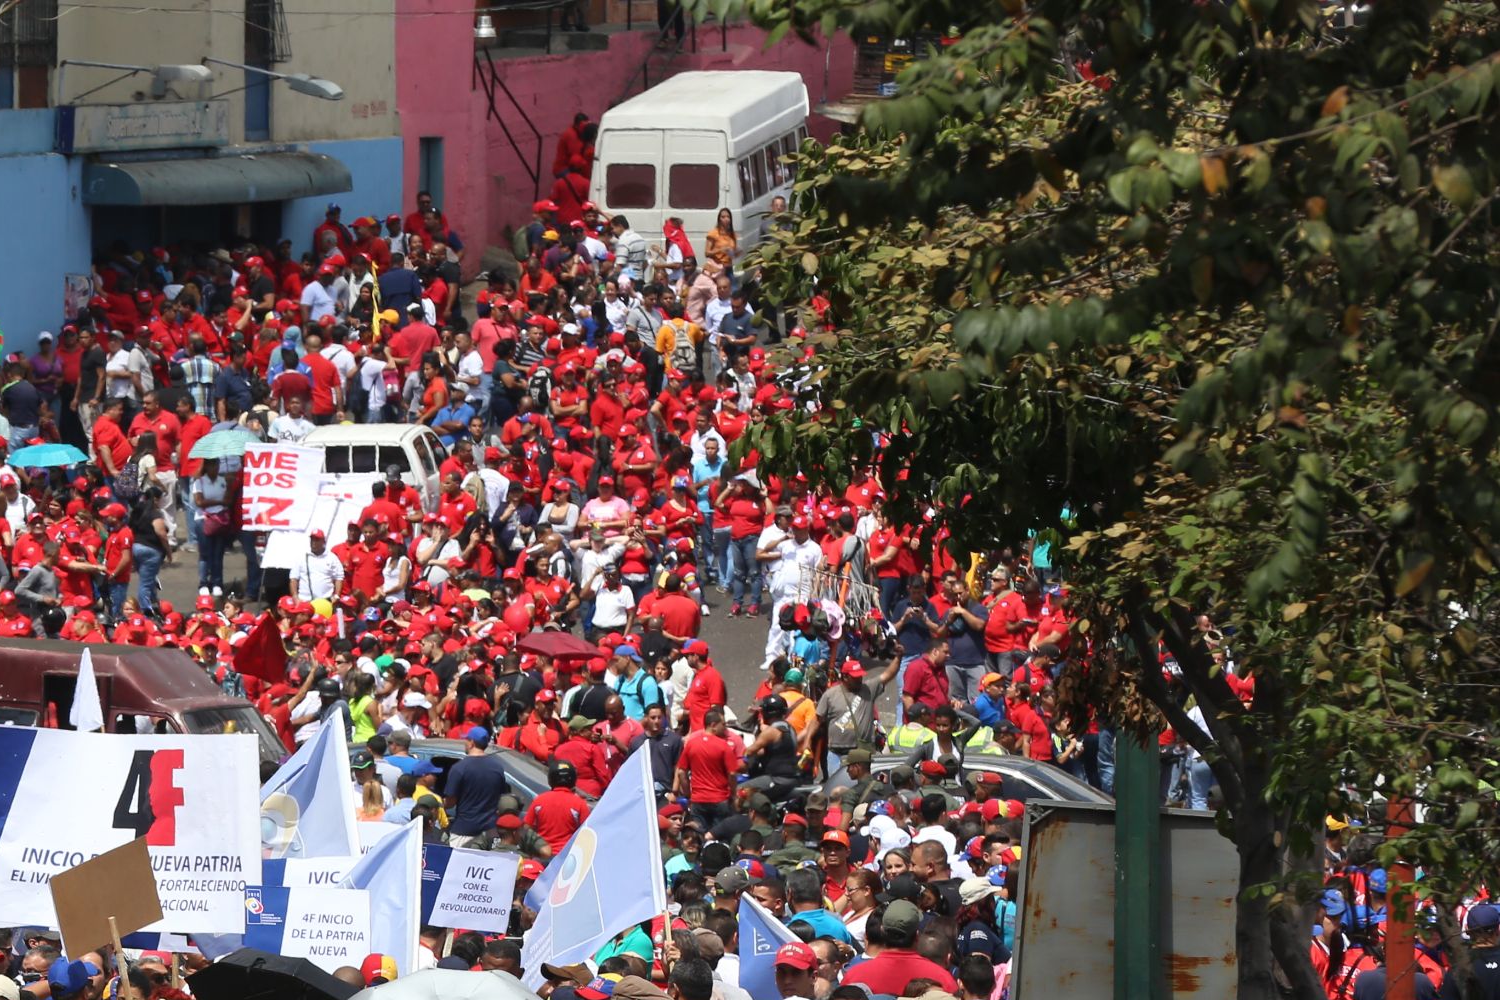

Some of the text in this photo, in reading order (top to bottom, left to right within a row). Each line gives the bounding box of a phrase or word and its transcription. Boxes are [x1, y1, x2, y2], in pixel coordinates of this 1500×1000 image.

[21, 847, 84, 868] INICIO
[151, 856, 190, 873] UEVA
[193, 856, 242, 873] PATRIA
[308, 871, 340, 885] IVIC
[466, 866, 494, 881] IVIC
[10, 869, 247, 892] EL IVI FORTALECIENDO
[463, 882, 489, 892] CON EL
[457, 892, 493, 904] PROCESO
[159, 899, 209, 912] ACIONAL
[440, 902, 506, 917] REVOLUCIONARIO
[302, 913, 354, 925] 4F INICIO
[291, 928, 365, 941] DE LA PATRIA
[309, 945, 347, 957] NUEVA
